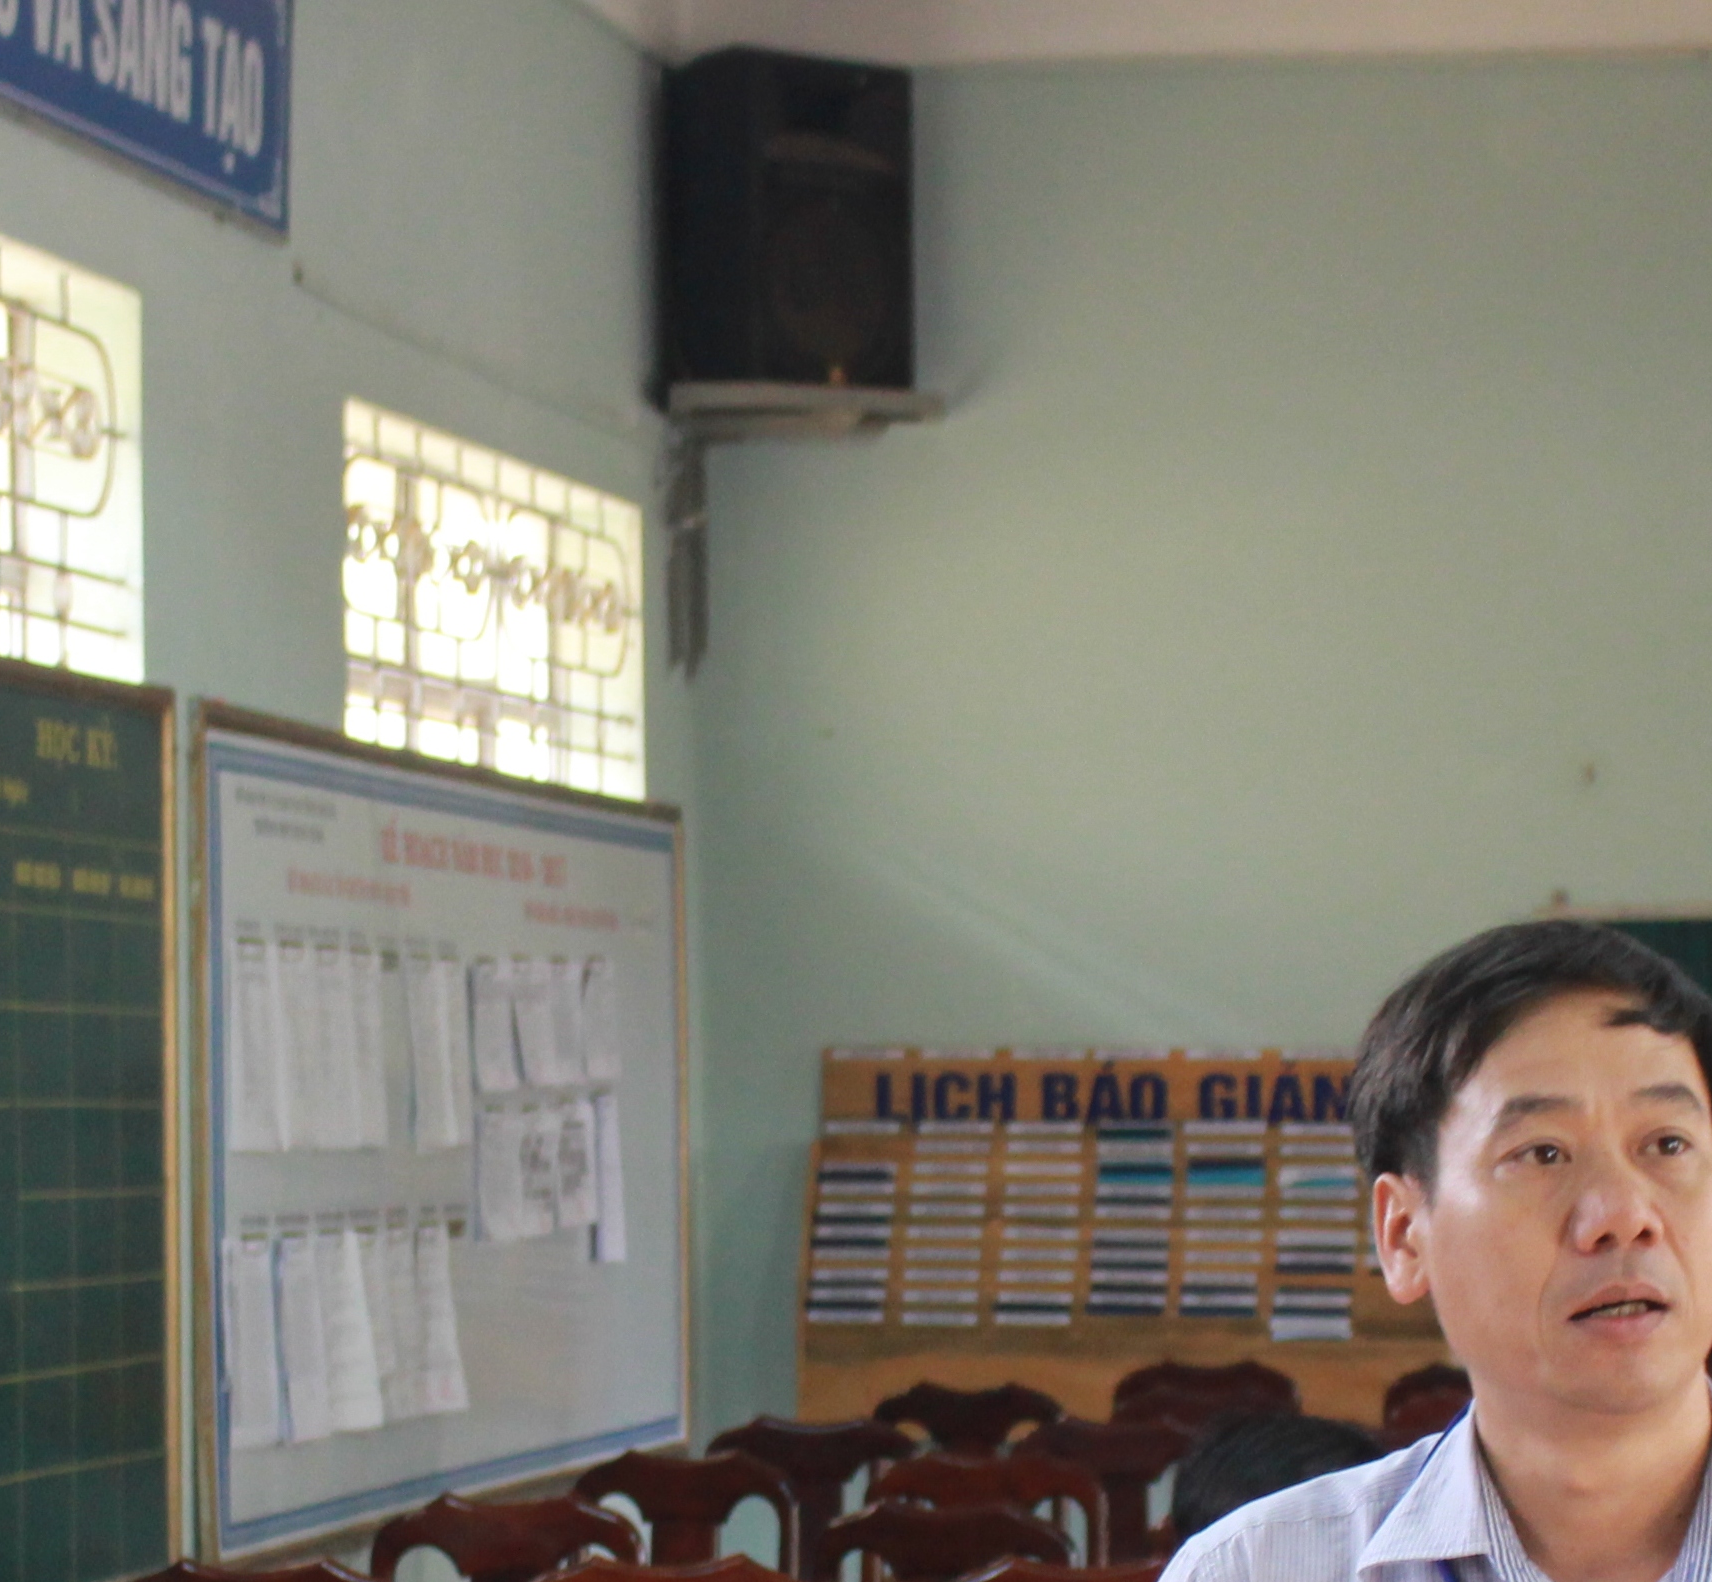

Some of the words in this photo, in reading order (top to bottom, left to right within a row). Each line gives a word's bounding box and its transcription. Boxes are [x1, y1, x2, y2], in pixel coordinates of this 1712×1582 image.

[202, 16, 264, 174] TẠO
[1040, 1060, 1169, 1125] BÁO
[1198, 1060, 1351, 1125] GIẢN
